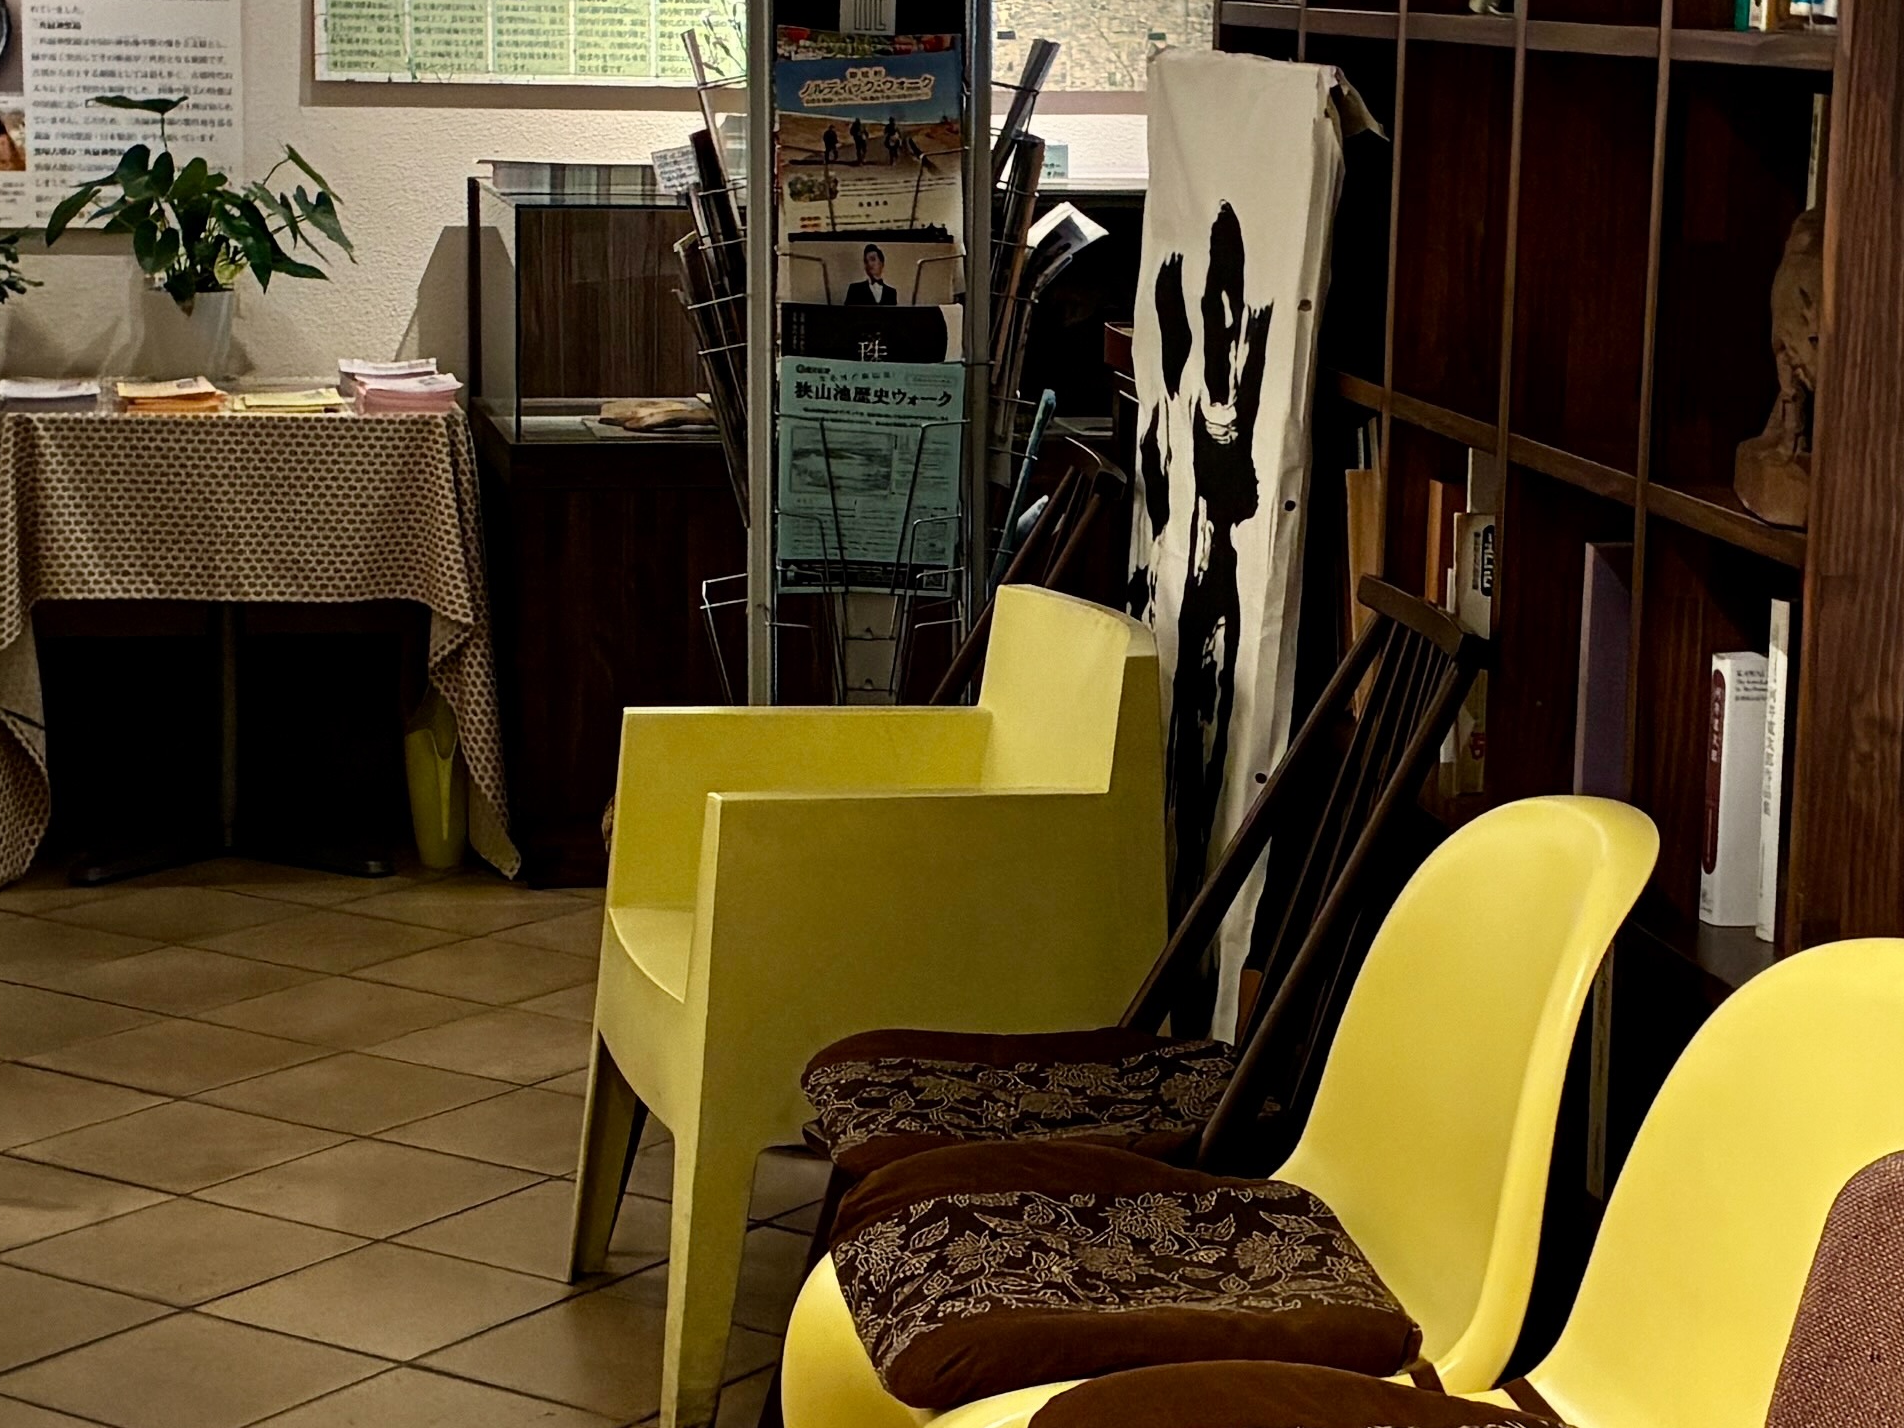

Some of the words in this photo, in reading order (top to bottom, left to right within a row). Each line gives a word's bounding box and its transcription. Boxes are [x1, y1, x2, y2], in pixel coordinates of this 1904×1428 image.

[794, 380, 953, 408] 狭山池歴史ウォーク
